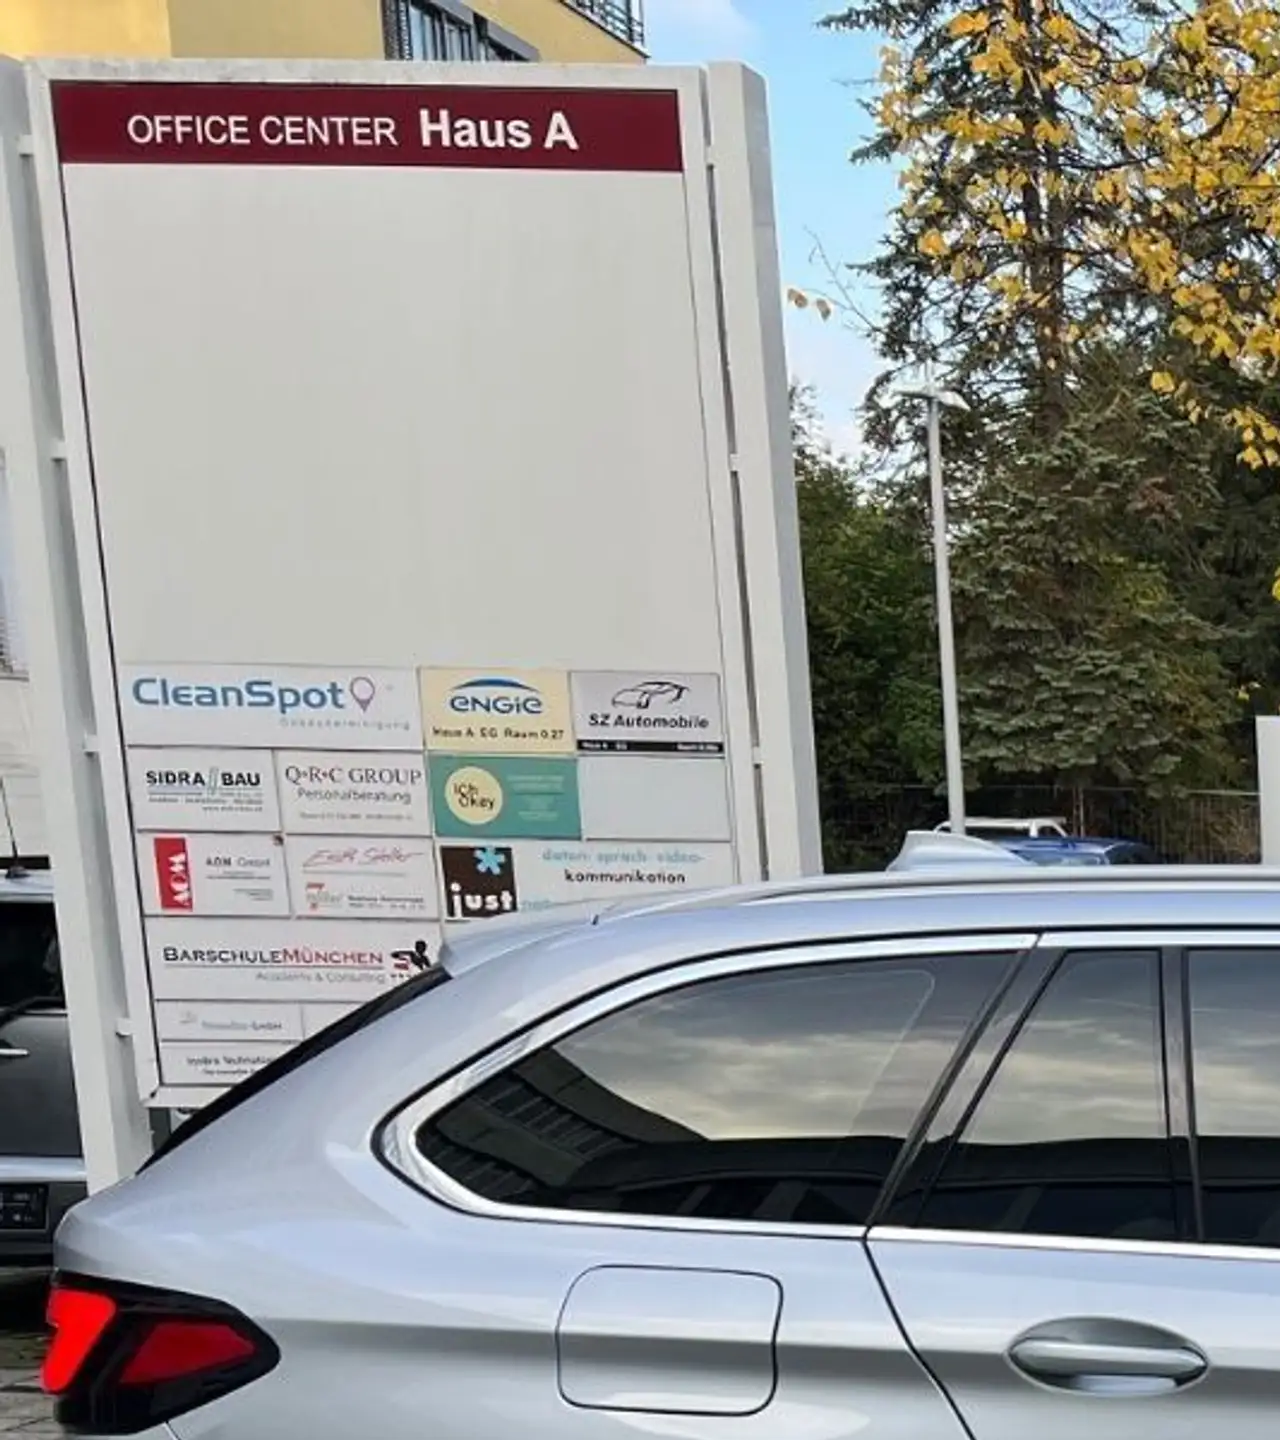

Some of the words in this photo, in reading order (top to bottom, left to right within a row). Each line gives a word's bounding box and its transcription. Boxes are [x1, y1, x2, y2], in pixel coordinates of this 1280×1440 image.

[126, 114, 249, 145] OFFICE
[259, 115, 399, 147] CENTER
[419, 108, 532, 149] Haus
[543, 111, 580, 149] A
[131, 677, 346, 715] CleanSpot
[588, 712, 611, 727] SZ
[613, 713, 710, 729] Automobile
[220, 771, 261, 787] BAU
[347, 766, 423, 786] GROUP
[564, 867, 686, 885] kommunikation
[450, 881, 514, 919] just
